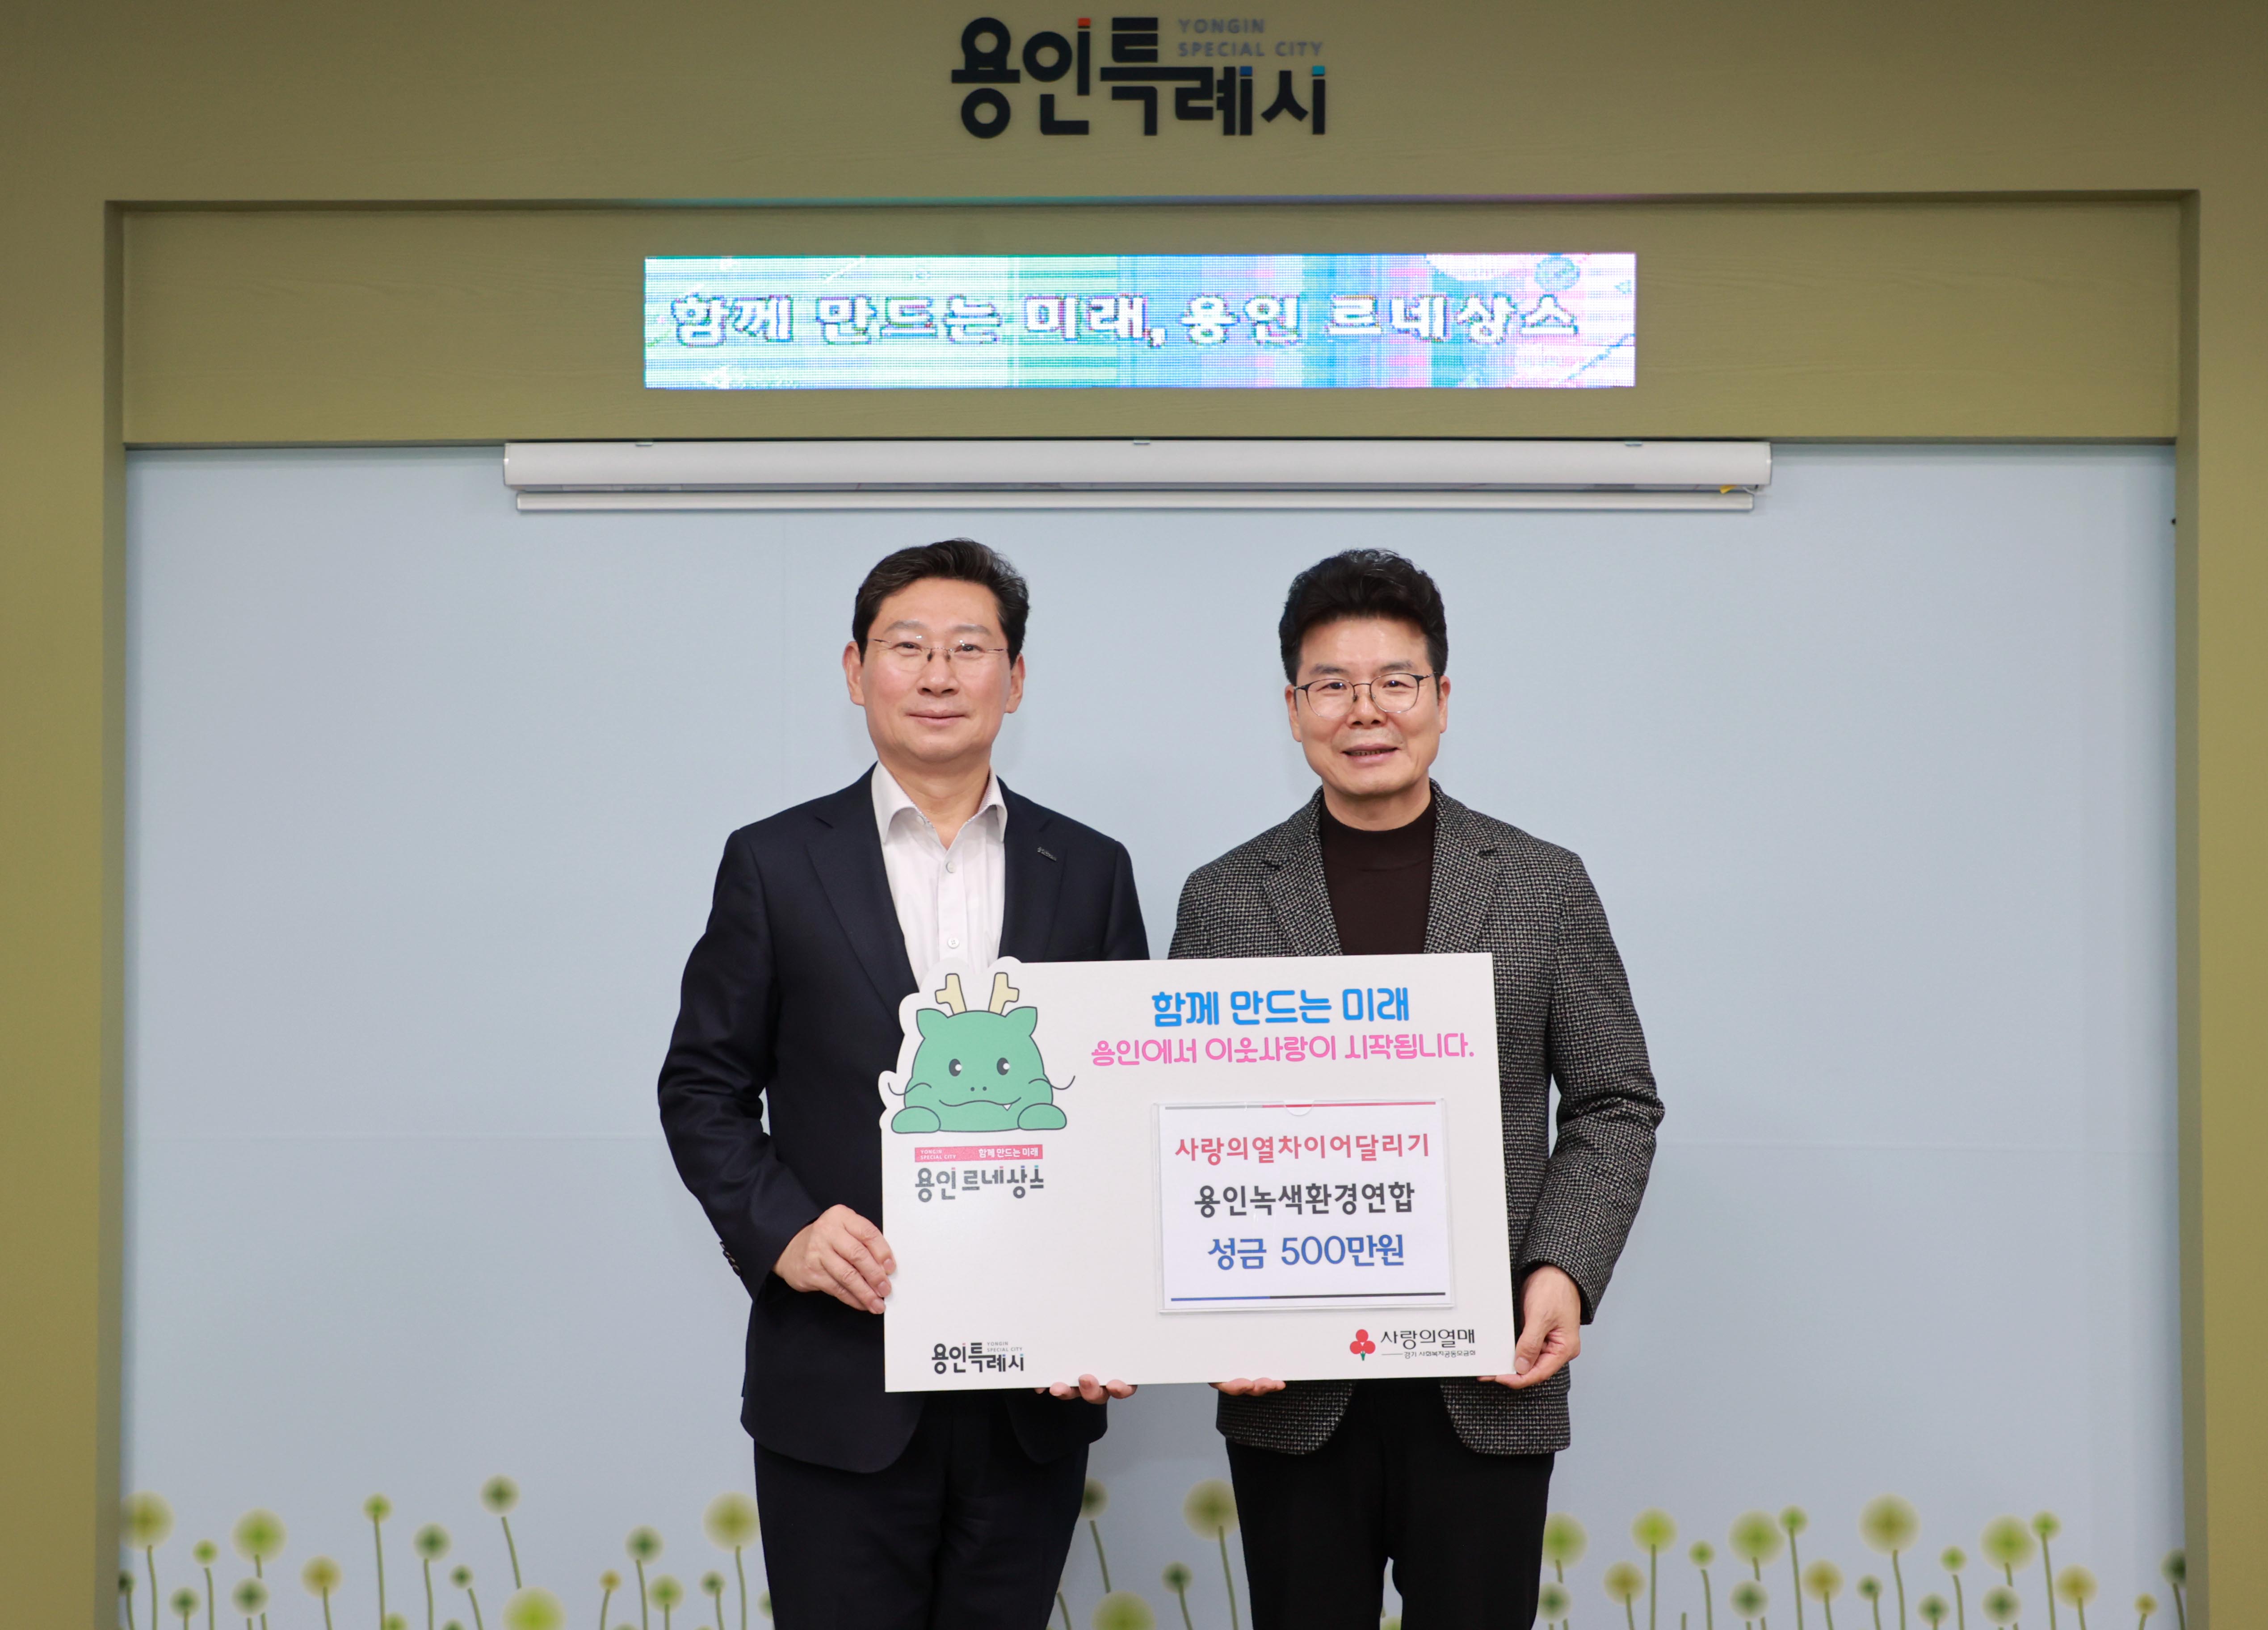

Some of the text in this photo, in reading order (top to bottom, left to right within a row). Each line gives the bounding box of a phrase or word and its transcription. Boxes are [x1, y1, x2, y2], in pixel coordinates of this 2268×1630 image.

[1179, 18, 1265, 34] YONGIN
[1178, 42, 1323, 56] SPECIAL CITY
[952, 17, 1326, 139] 용인특례시
[671, 293, 1579, 348] 함께 만드는 미래, 용인 르네상스
[1151, 987, 1409, 1027] 함께 만드는 미래
[1091, 1033, 1474, 1067] 용인에서 이웃사랑이 시작됩니다.
[979, 1147, 1039, 1158] 함께 만드는 미래
[1175, 1133, 1428, 1166] 사랑의열차이어달리기
[915, 1165, 1044, 1203] 용인 르네상스
[1194, 1181, 1415, 1218] 용인녹색환경연합
[1208, 1234, 1404, 1270] 성금 500만원
[1380, 1329, 1475, 1350] 사랑의열매
[932, 1342, 1024, 1374] 용인특례시
